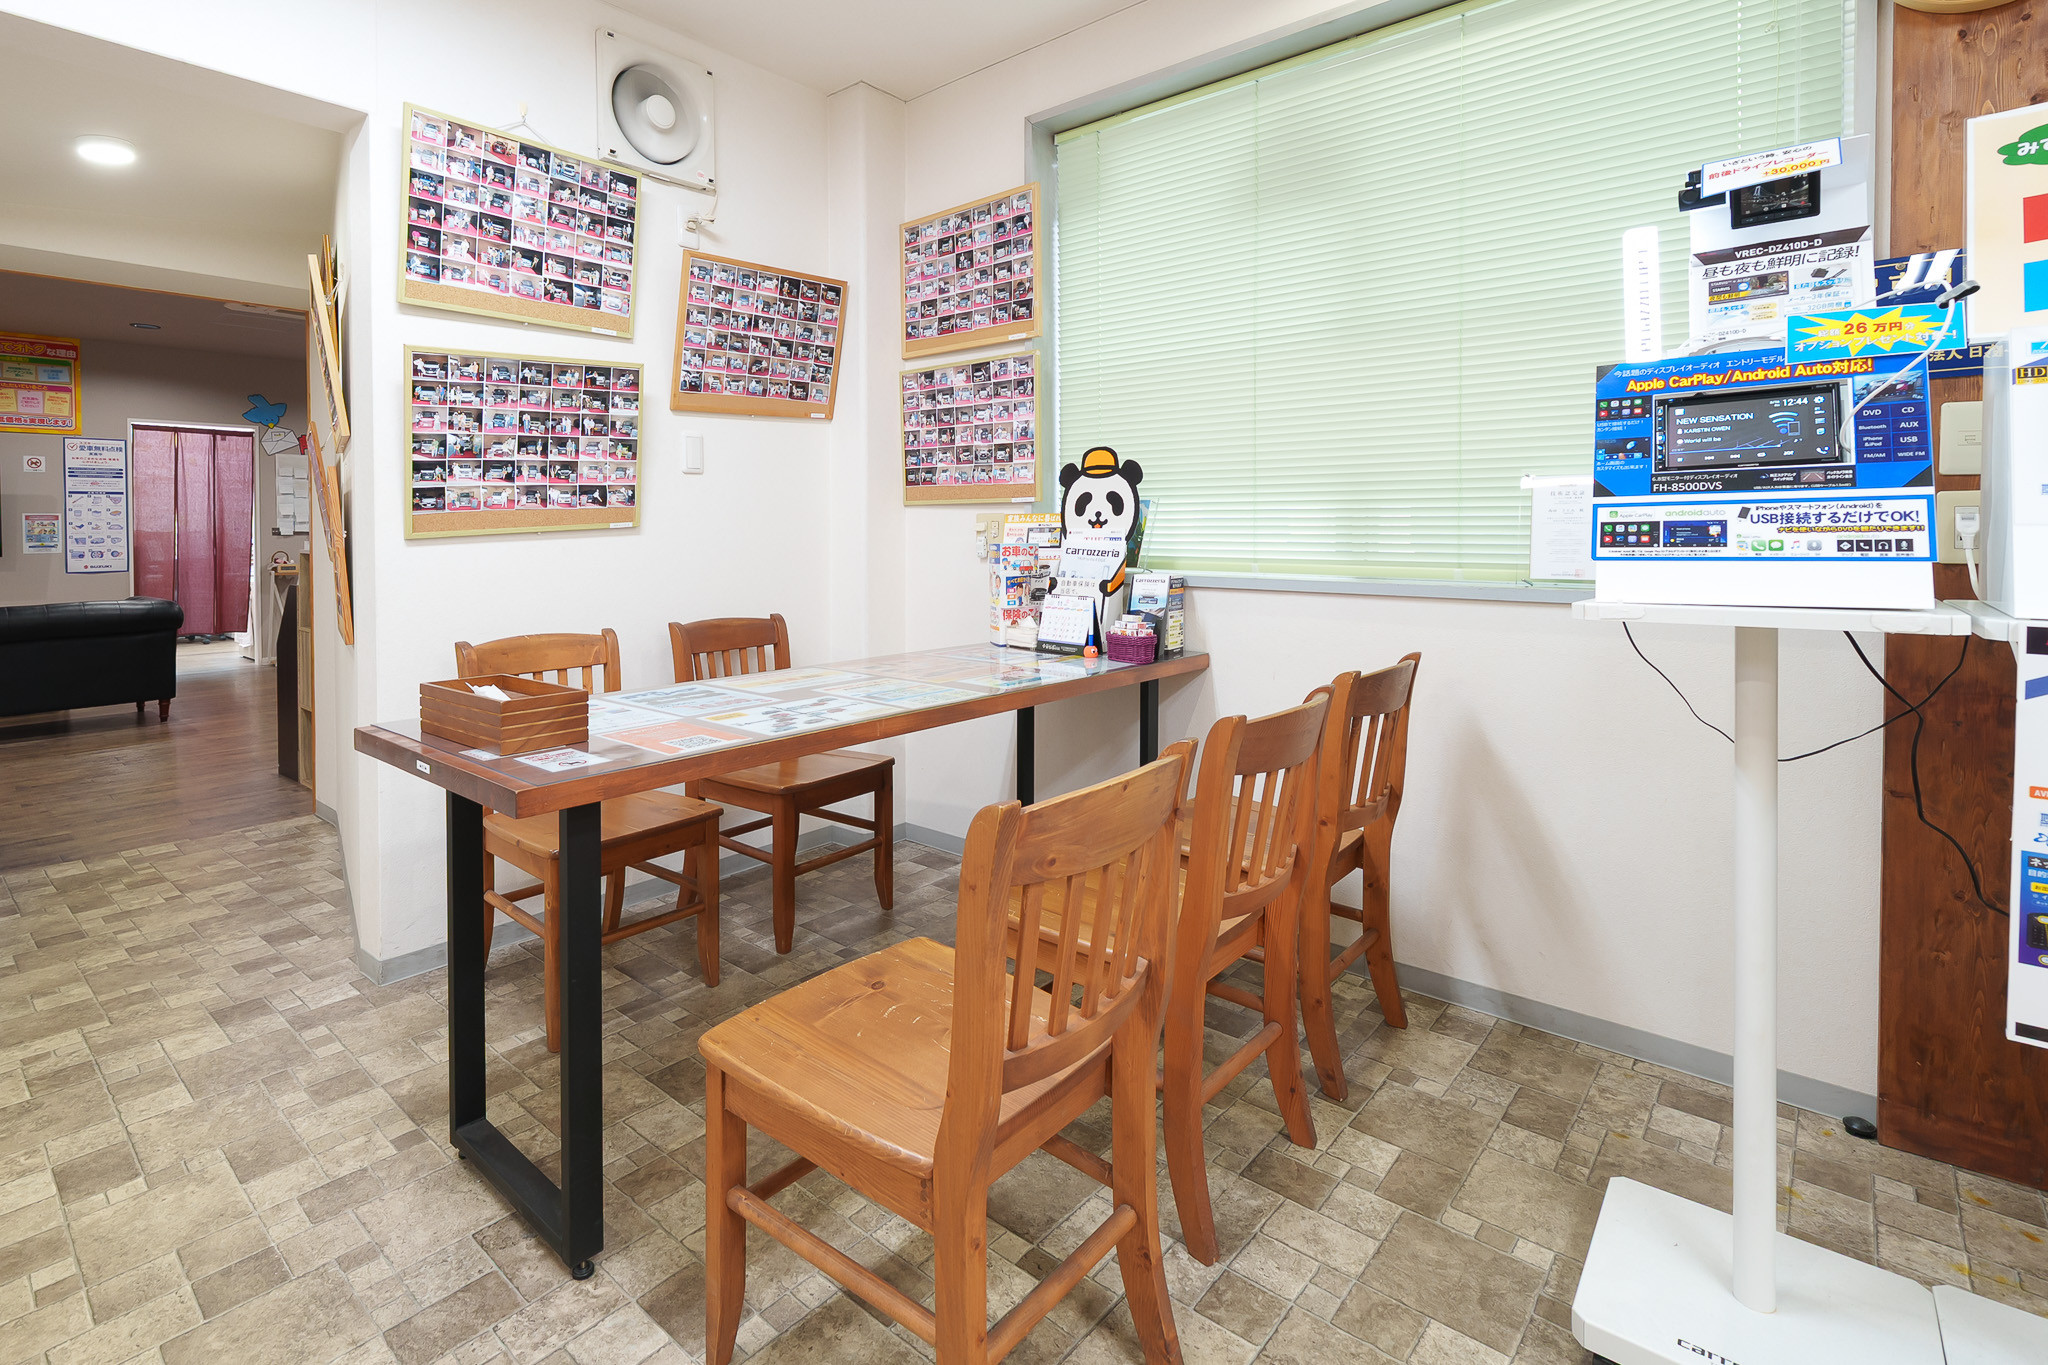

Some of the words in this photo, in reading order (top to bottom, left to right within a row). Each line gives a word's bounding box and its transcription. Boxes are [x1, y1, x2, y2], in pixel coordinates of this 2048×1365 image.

[1708, 151, 1829, 180] 前後ドライブレコーダー
[1734, 238, 1823, 259] VREC-DZ410D-D
[1702, 245, 1861, 280] 昼も夜も鮮明に記録!
[1844, 322, 1868, 335] 26
[1613, 361, 1720, 378] 今話題のディスプレイオーディオ
[1726, 355, 1785, 367] エントリーモデル
[2020, 366, 2047, 378] HD
[1626, 378, 1665, 393] Apple
[1668, 365, 1791, 388] CarPlay/Android
[1794, 358, 1873, 377] Auto対応!
[1782, 397, 1809, 407] 12:44
[1862, 408, 1882, 416] DVD
[1901, 406, 1915, 414] CD
[1676, 417, 1698, 426] NEW
[1700, 412, 1754, 424] SENSATION
[1900, 435, 1919, 443] USB
[1653, 481, 1723, 493] FH-8500DVS
[1750, 510, 1920, 525] USB接続するだけでOK!
[1001, 545, 1039, 557] お車のこと
[1065, 547, 1120, 558] carrozzeria
